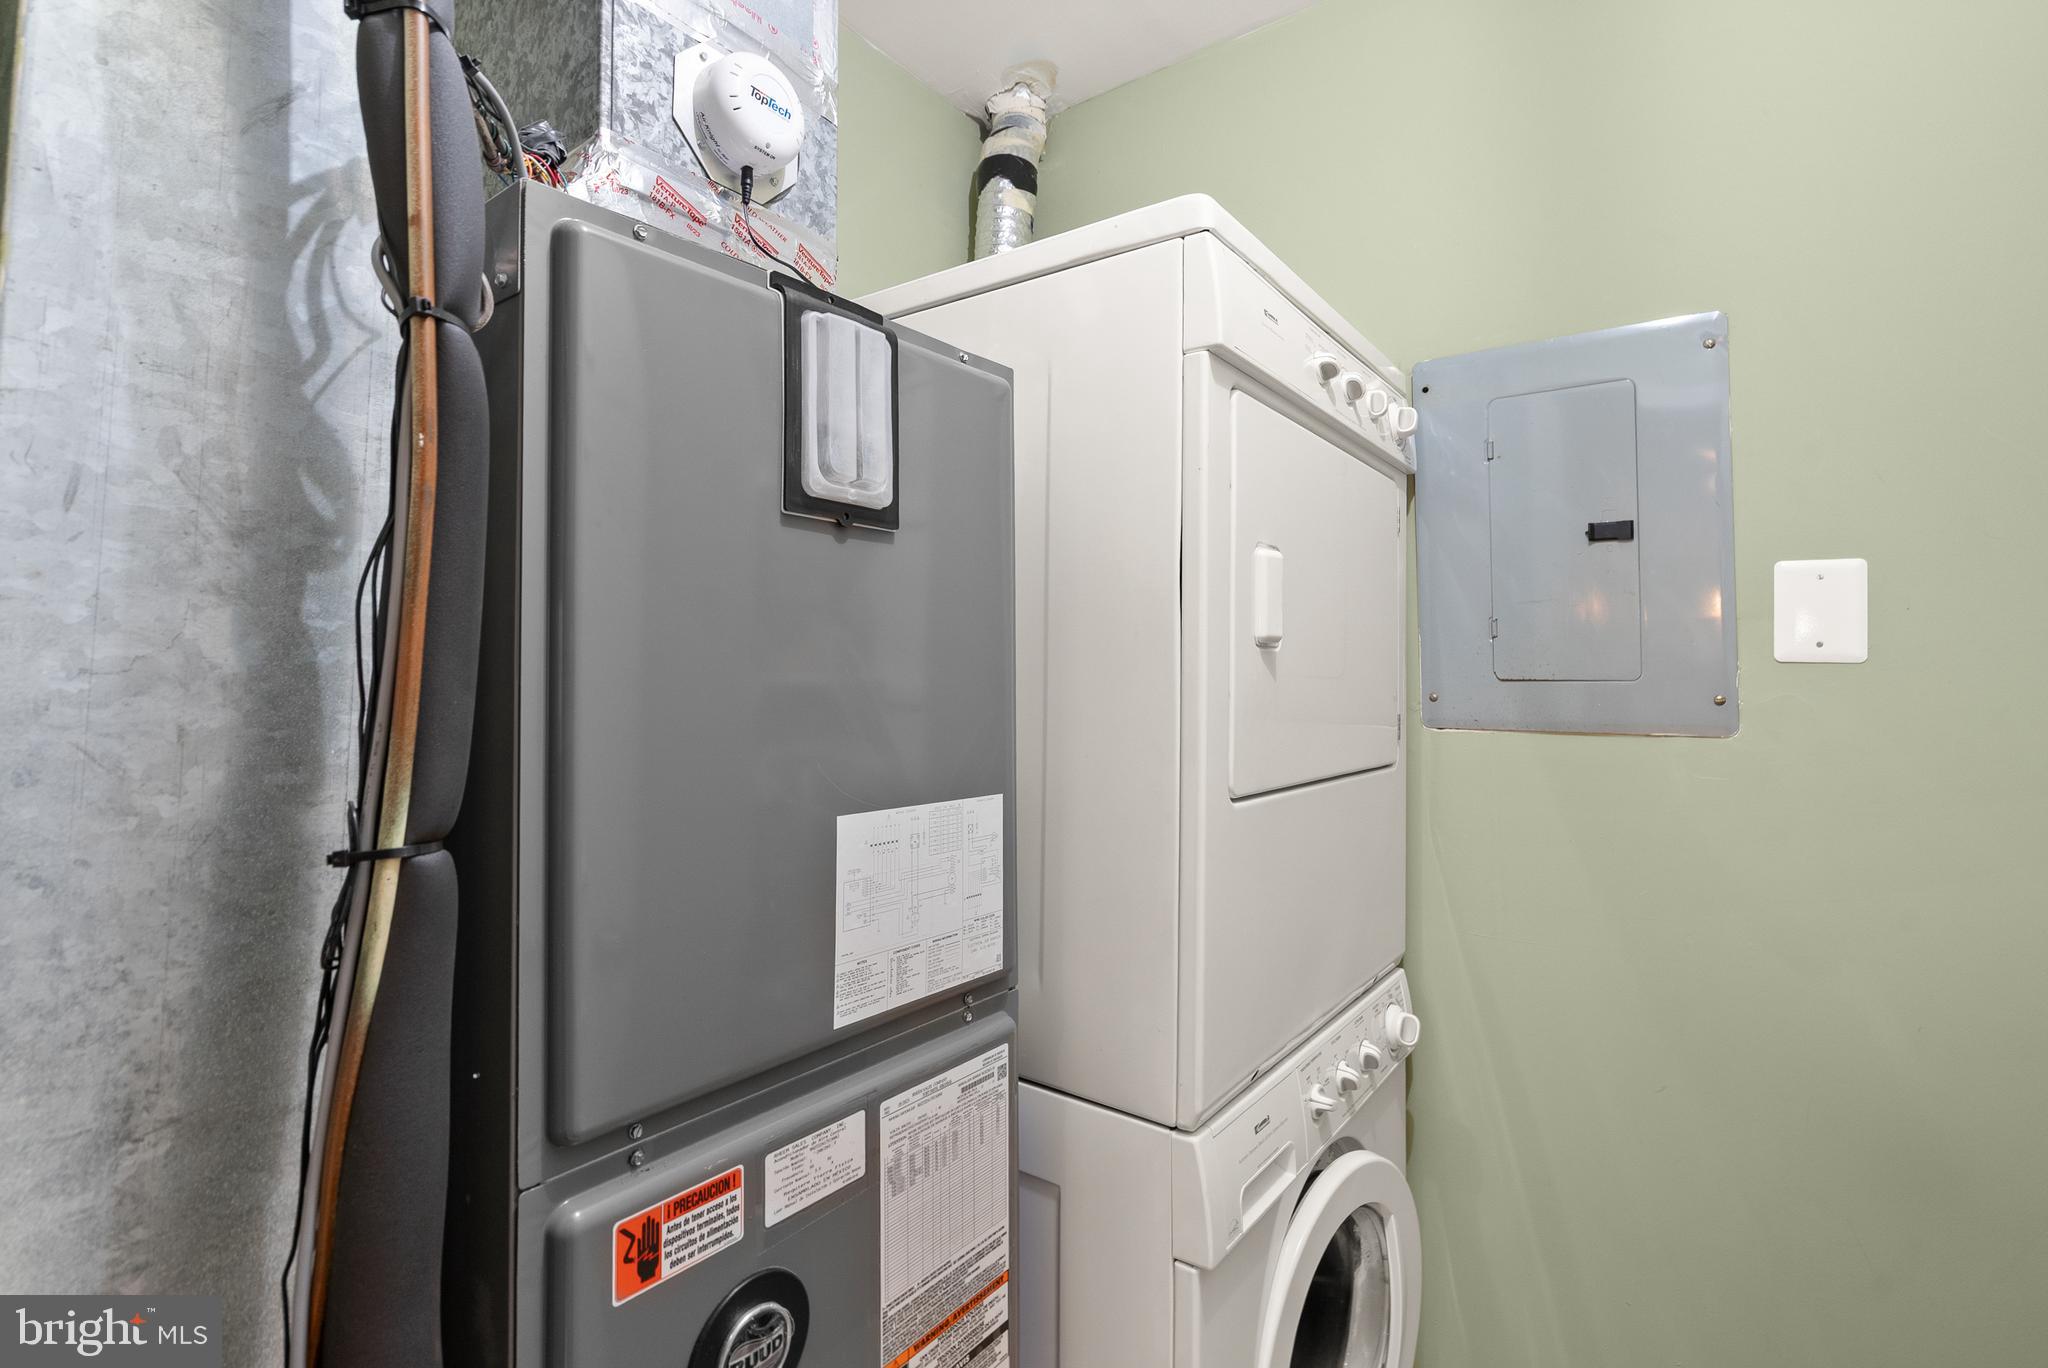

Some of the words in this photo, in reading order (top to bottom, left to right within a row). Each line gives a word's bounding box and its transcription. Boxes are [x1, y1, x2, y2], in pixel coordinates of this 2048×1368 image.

[750, 85, 791, 119] TopTech
[666, 1221, 682, 1234] Antes
[683, 1217, 690, 1227] de
[691, 1210, 705, 1223] tener
[706, 1202, 724, 1216] acceso
[729, 1193, 738, 1202] los
[673, 1176, 731, 1213] PRECAUCION
[663, 1227, 696, 1249] dispositivos
[696, 1213, 725, 1232] terminales,
[726, 1203, 740, 1217] todos
[664, 1250, 673, 1260] los
[674, 1236, 698, 1255] circuitos
[699, 1233, 706, 1242] de
[706, 1215, 739, 1238] alimentación
[669, 1256, 687, 1270] deben
[687, 1249, 696, 1260] ser
[697, 1230, 735, 1255] interrumpidos.
